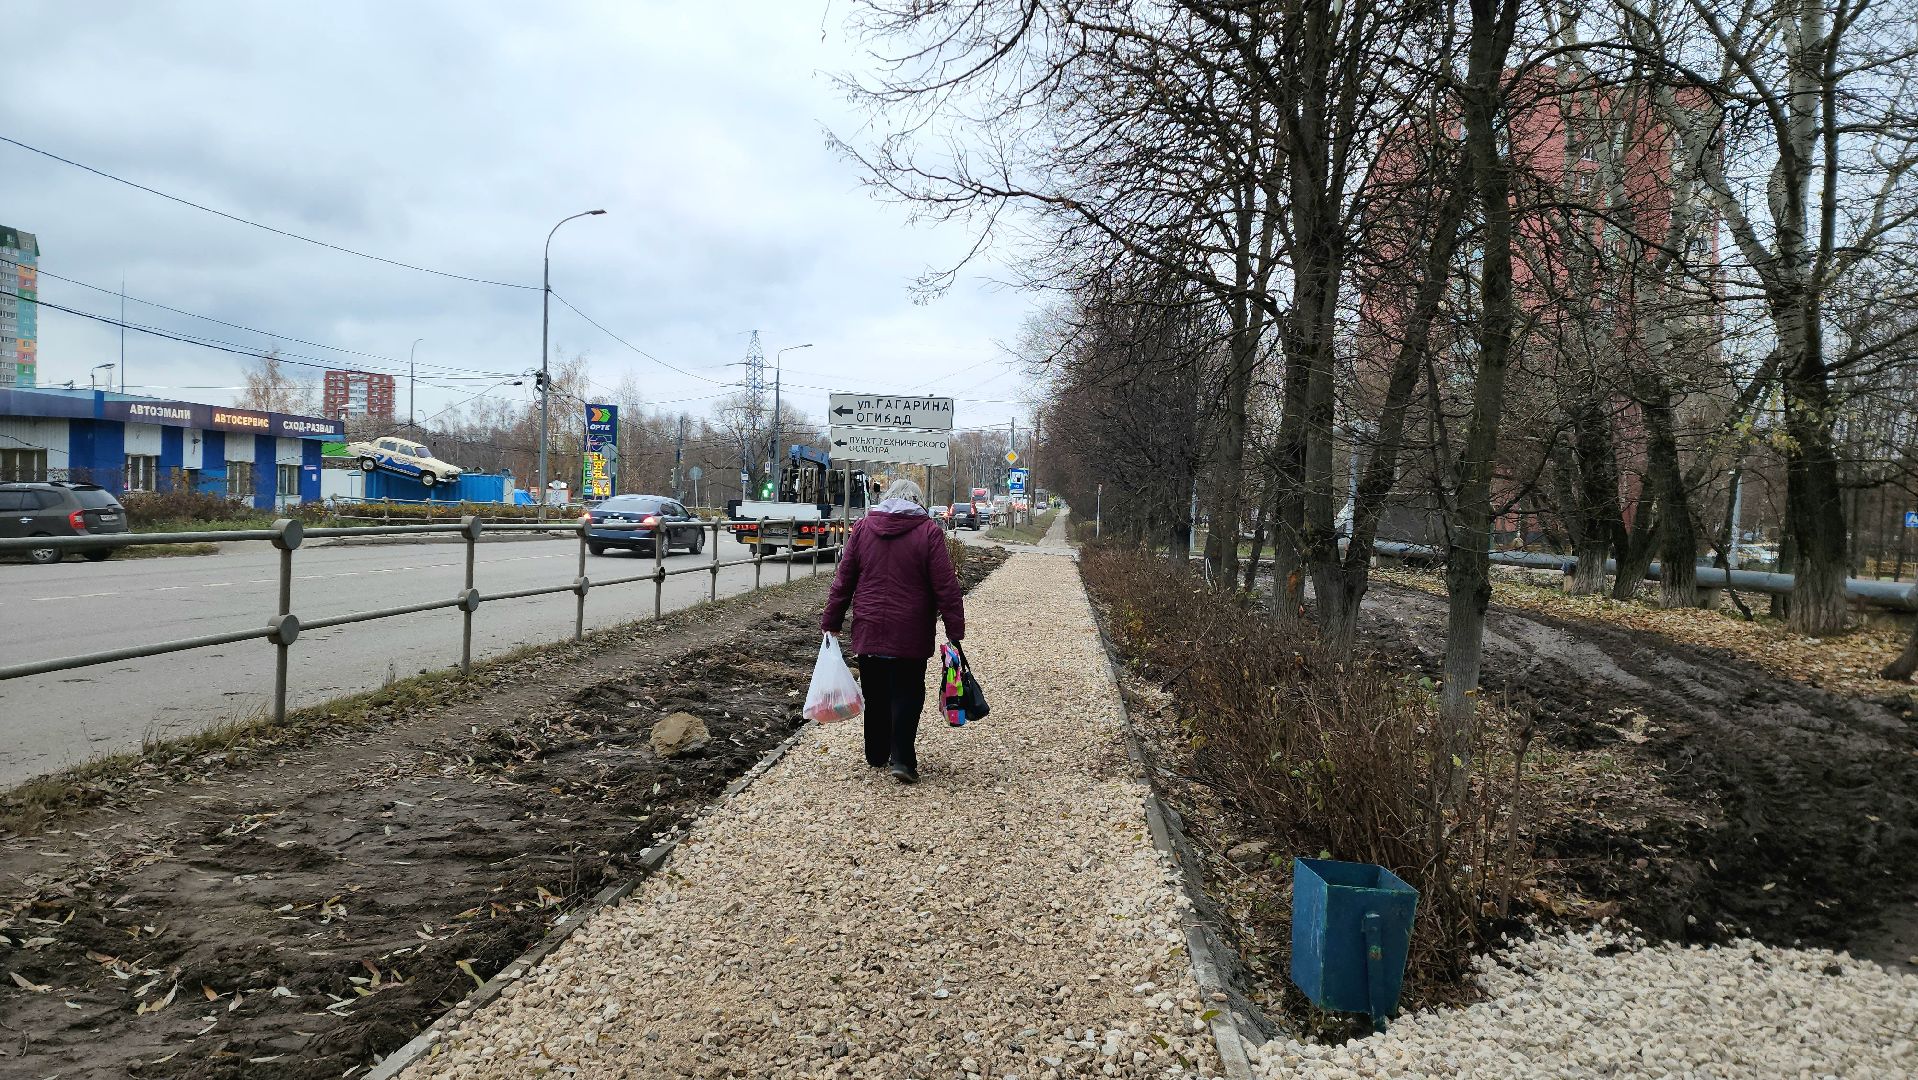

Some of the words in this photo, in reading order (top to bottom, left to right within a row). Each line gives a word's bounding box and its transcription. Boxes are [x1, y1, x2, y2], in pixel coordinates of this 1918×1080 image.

[129, 403, 191, 420] АВТОЭМАЛИ
[214, 413, 269, 428] АВТОСЕРВИС
[283, 420, 335, 434] СХОД-РАЗВАЛ
[849, 436, 877, 445] ПУНКТ
[878, 437, 946, 449] ТЕХНИЧЕСКОГО
[849, 445, 889, 454] ОСМОТРА
